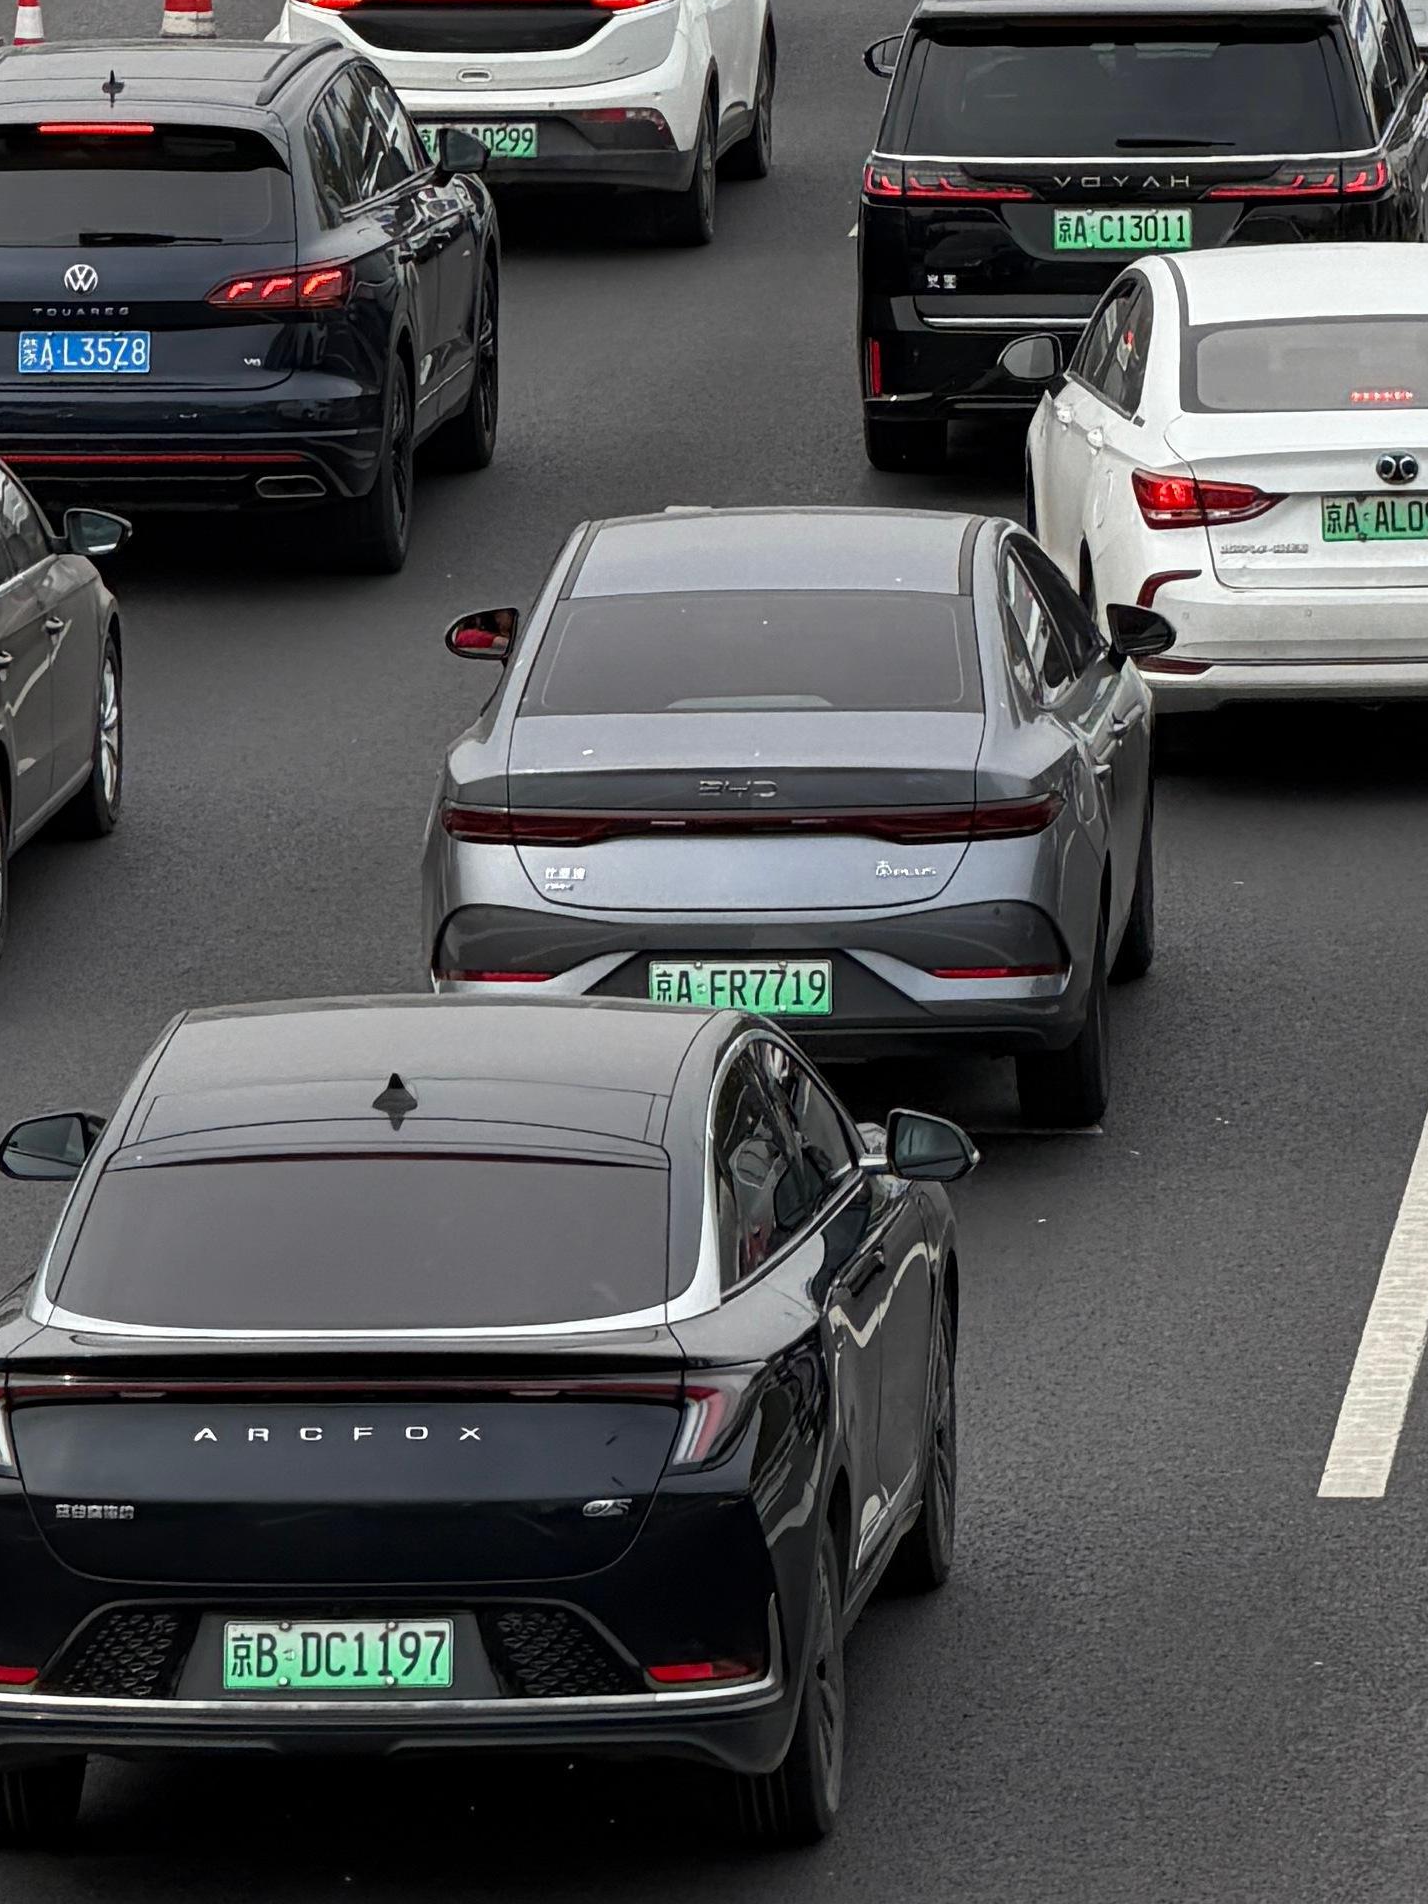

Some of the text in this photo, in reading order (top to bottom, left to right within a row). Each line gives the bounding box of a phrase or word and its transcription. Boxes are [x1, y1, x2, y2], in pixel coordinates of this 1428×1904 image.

[1053, 175, 1190, 187] VOYAH
[32, 307, 129, 316] TOUAREG
[194, 1427, 482, 1442] ARCFOX
